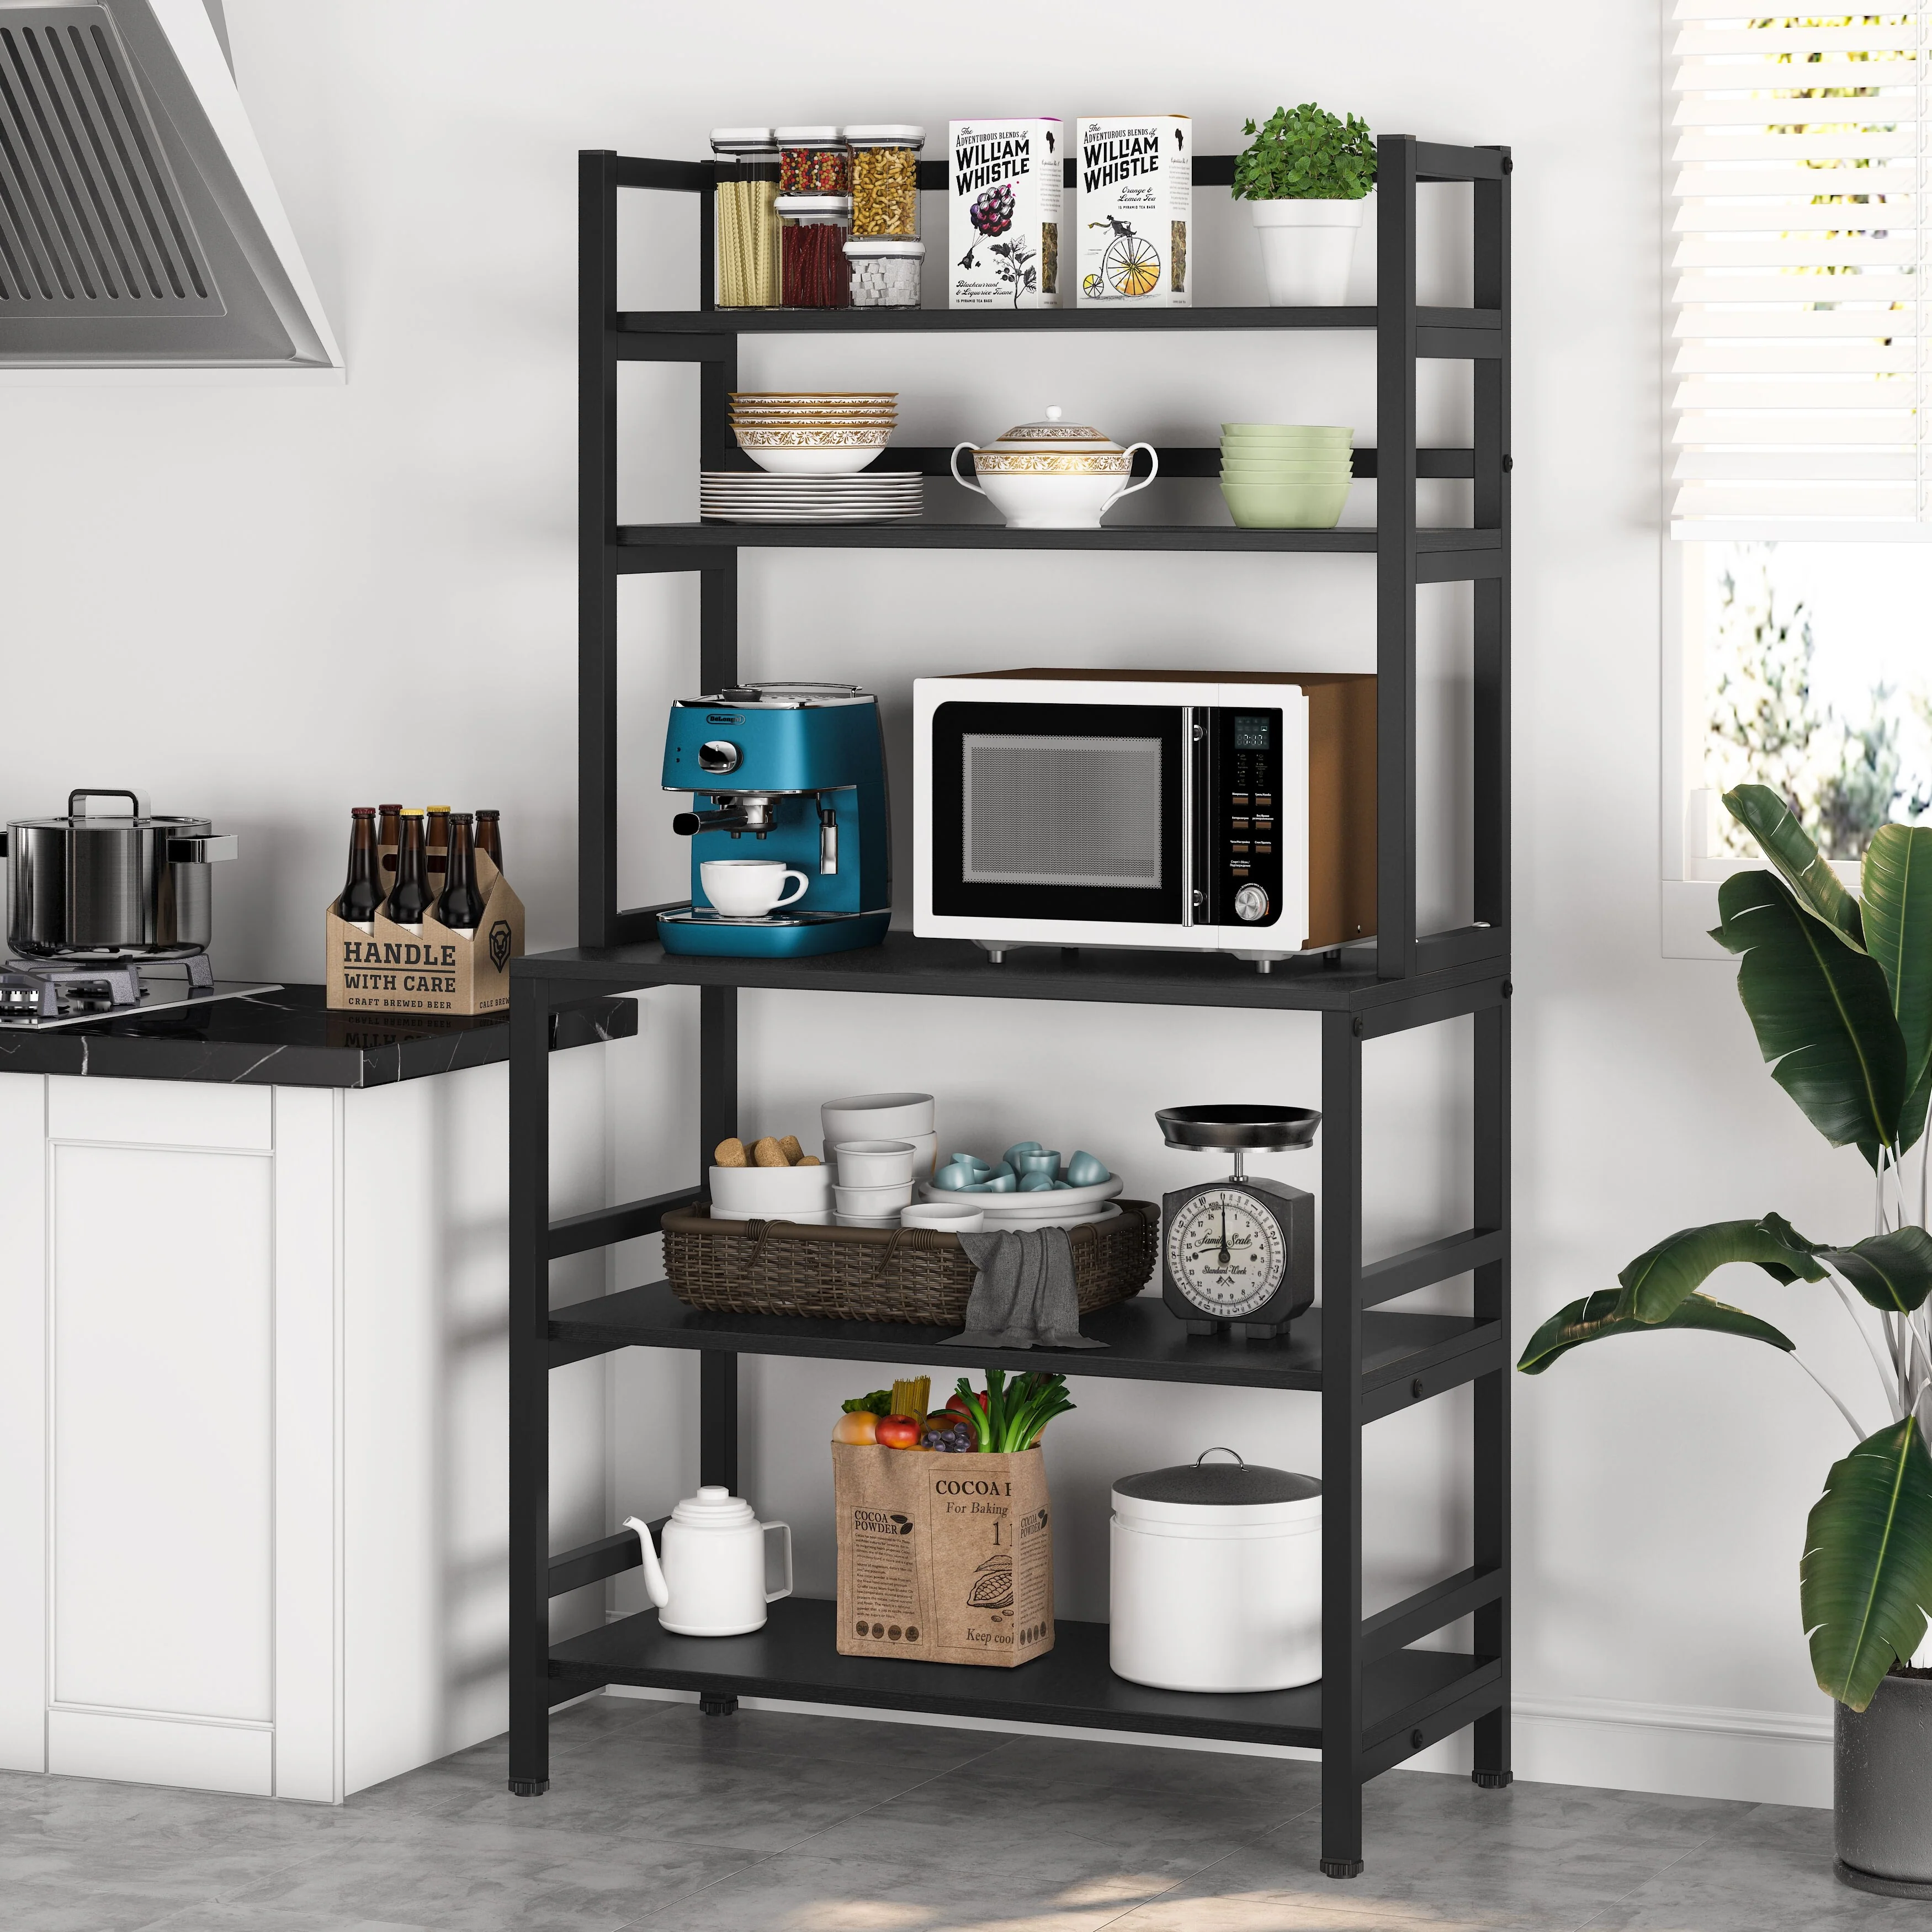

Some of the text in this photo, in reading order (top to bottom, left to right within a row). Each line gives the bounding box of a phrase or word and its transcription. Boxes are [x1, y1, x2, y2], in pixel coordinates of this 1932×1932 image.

[961, 126, 973, 136] The
[1089, 124, 1101, 132] The
[956, 132, 997, 147] ADVENTUROUS
[1084, 130, 1126, 144] ADVENTUROUS
[956, 139, 1029, 172] WILLIAM
[1084, 137, 1159, 168] WILLIAM
[956, 157, 1029, 197] WHISTLE
[1084, 155, 1159, 194] WHISTLE
[1122, 186, 1145, 195] Orange
[962, 288, 992, 298] Liquorice
[344, 941, 456, 966] HANDLE
[344, 973, 456, 993] WITH CARE
[348, 997, 452, 1010] CRAFT BREWED BEER
[480, 1000, 493, 1009] CALE
[1198, 1196, 1206, 1206] 10
[1226, 1233, 1252, 1248] Scale
[1270, 1230, 1277, 1240] 2
[1273, 1265, 1279, 1273] 3
[936, 1480, 1000, 1496] COCOA
[854, 1510, 888, 1523] COCOA
[946, 1502, 1009, 1519] For Baking
[855, 1520, 898, 1535] POWDER
[1021, 1514, 1037, 1528] COCOA
[993, 1521, 1000, 1546] 1
[1021, 1522, 1041, 1538] POWDER
[966, 1628, 1014, 1646] Keep cool
